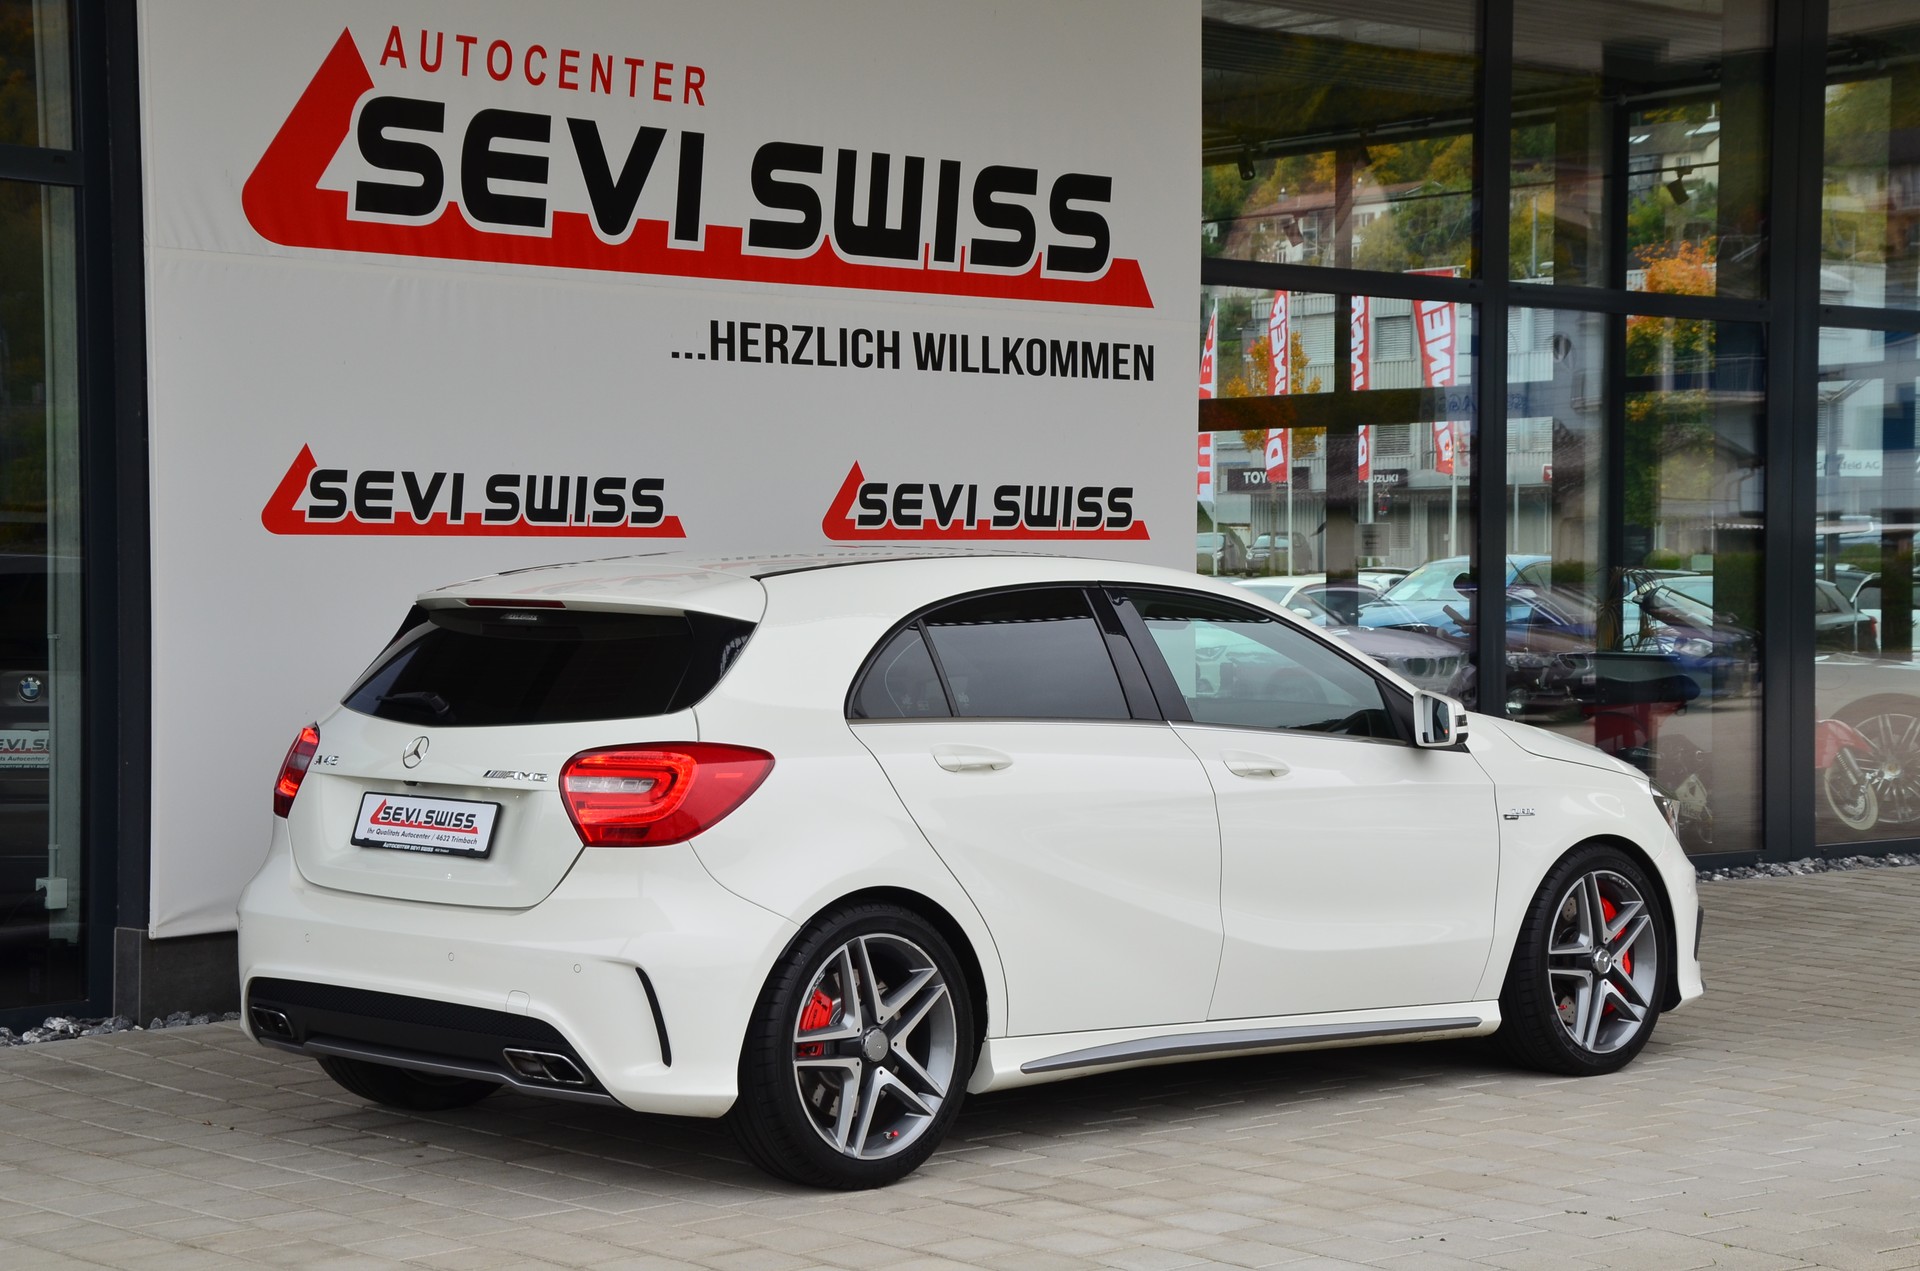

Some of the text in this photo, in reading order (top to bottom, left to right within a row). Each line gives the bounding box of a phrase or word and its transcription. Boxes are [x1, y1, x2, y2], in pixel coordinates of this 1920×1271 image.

[379, 25, 706, 107] AUTOCENTER
[355, 95, 1113, 274] SEVI SWISS
[670, 319, 1155, 382] ...HERZLICH WILLKOMMEN
[308, 468, 665, 524] SEVI SWISS
[857, 482, 1134, 528] SEVI SWISS
[314, 755, 322, 765] A
[503, 770, 548, 782] AMG
[381, 805, 477, 829] SEVI SWISS
[400, 831, 431, 840] Autocenter
[435, 834, 450, 842] 4632
[451, 836, 478, 845] Trimbach
